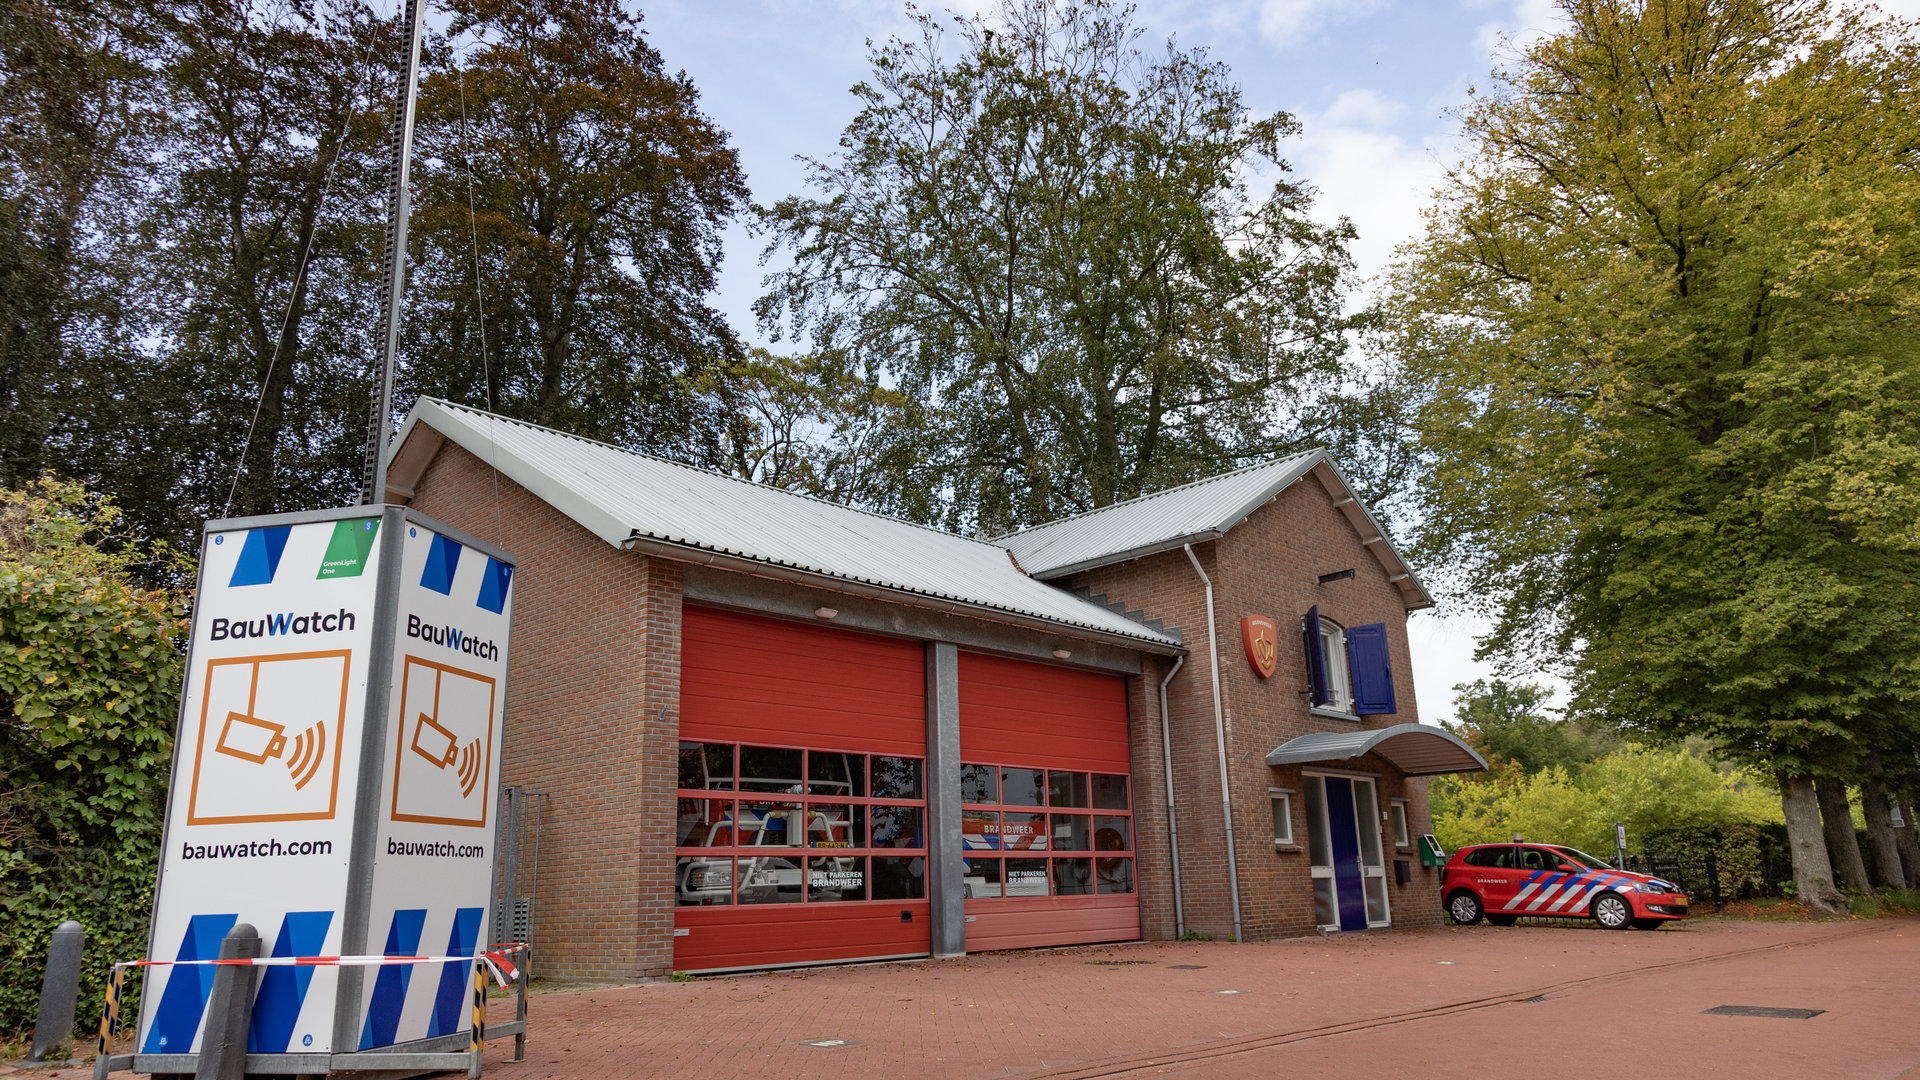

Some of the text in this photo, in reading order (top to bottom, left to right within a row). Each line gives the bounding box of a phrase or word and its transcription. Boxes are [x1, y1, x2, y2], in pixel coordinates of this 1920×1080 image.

[323, 559, 357, 567] GreenLight
[210, 608, 356, 641] BauWatch
[407, 613, 498, 662] BauWatch
[984, 825, 1033, 834] BRANDWEER
[182, 838, 333, 860] bauwatch.com
[387, 837, 484, 859] bauwatch.com
[813, 879, 862, 887] BRANDWEER
